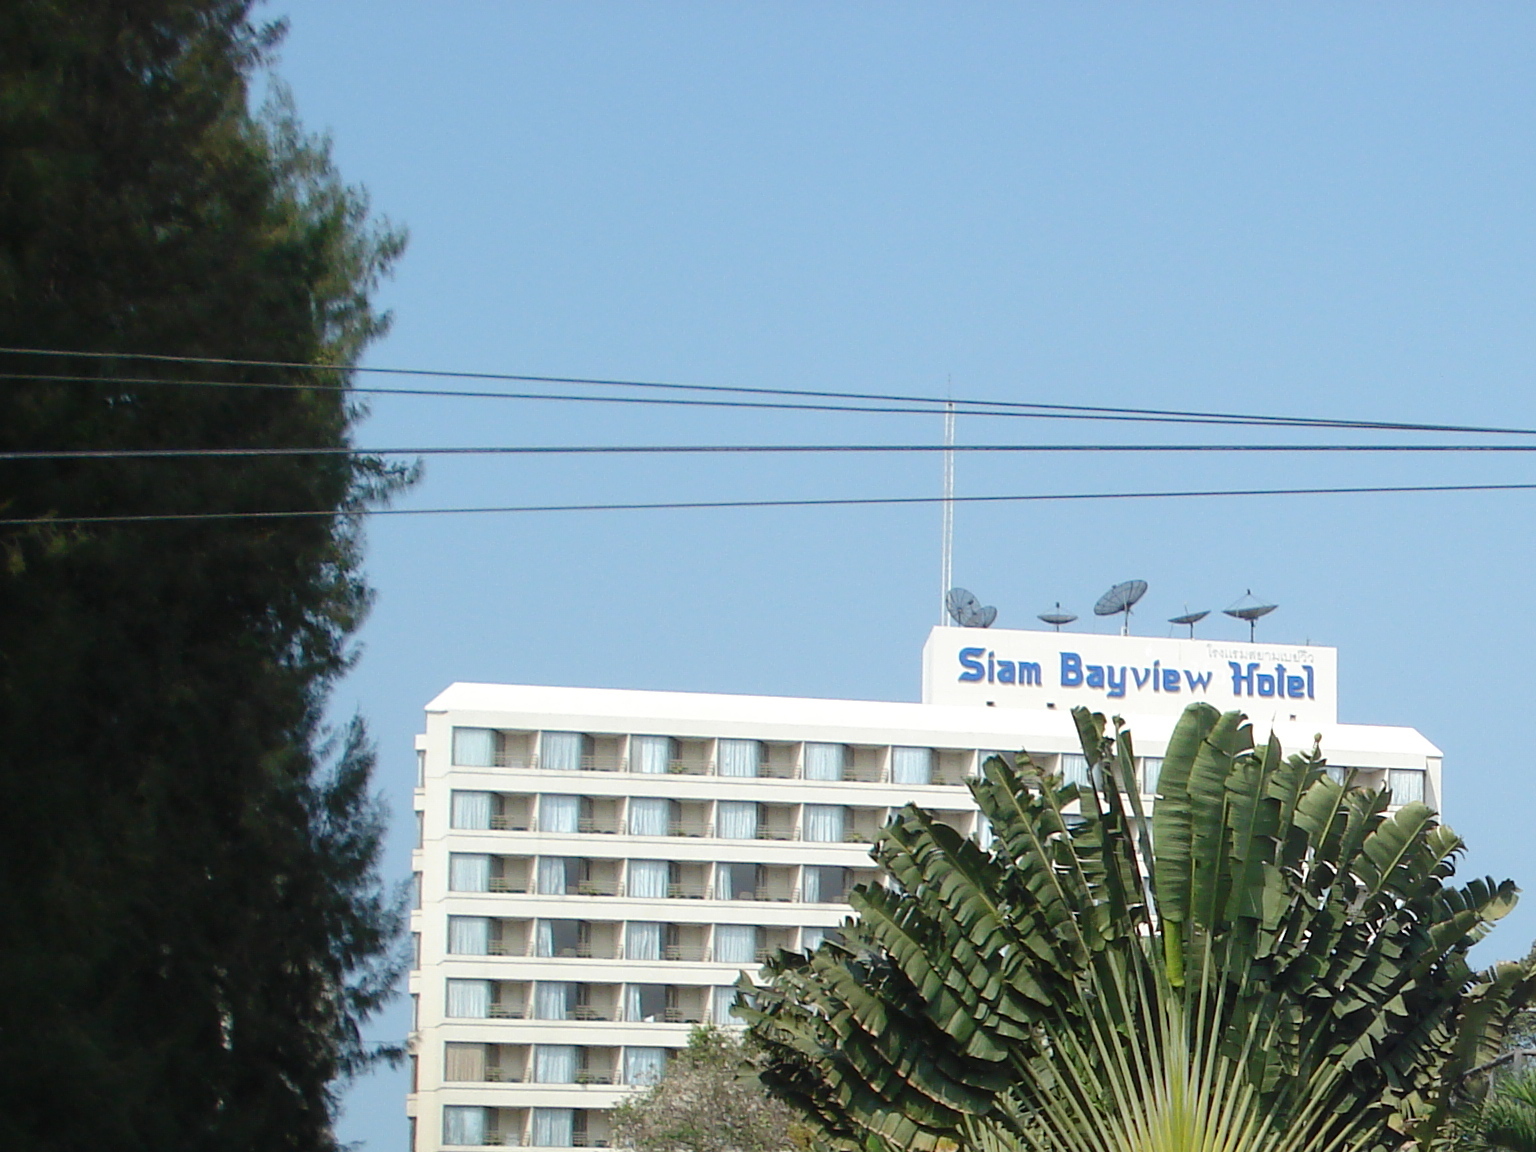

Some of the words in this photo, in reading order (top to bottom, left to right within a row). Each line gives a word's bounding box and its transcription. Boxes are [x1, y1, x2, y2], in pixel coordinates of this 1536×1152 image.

[958, 647, 1042, 686] Siam
[1059, 651, 1213, 698] Bayview
[1228, 660, 1315, 700] Hotel
